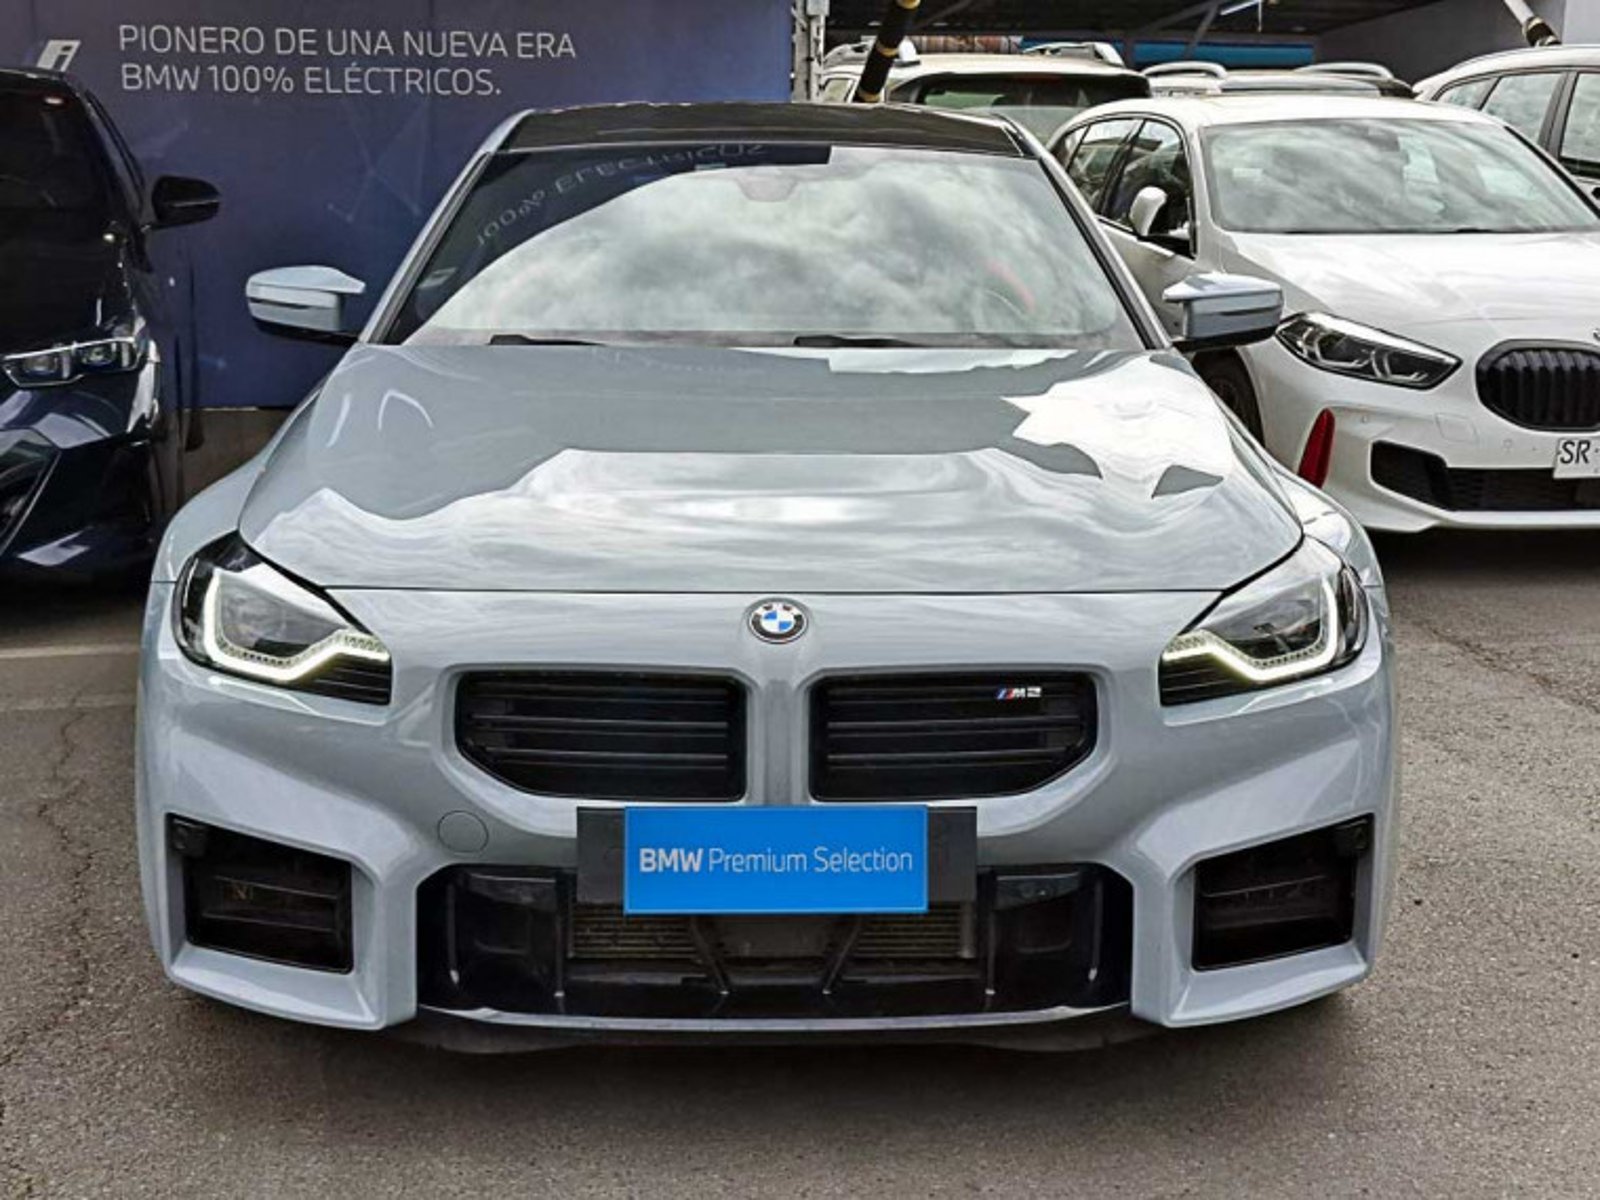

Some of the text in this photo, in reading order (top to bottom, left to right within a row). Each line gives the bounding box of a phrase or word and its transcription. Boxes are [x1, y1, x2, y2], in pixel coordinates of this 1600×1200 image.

[119, 24, 576, 59] PIONERO DE UNA NUEVA ERA
[121, 61, 502, 96] BMW 100% ELÉCTRICOS.
[1560, 440, 1591, 464] SR
[638, 845, 913, 873] BMW Premium Selection
